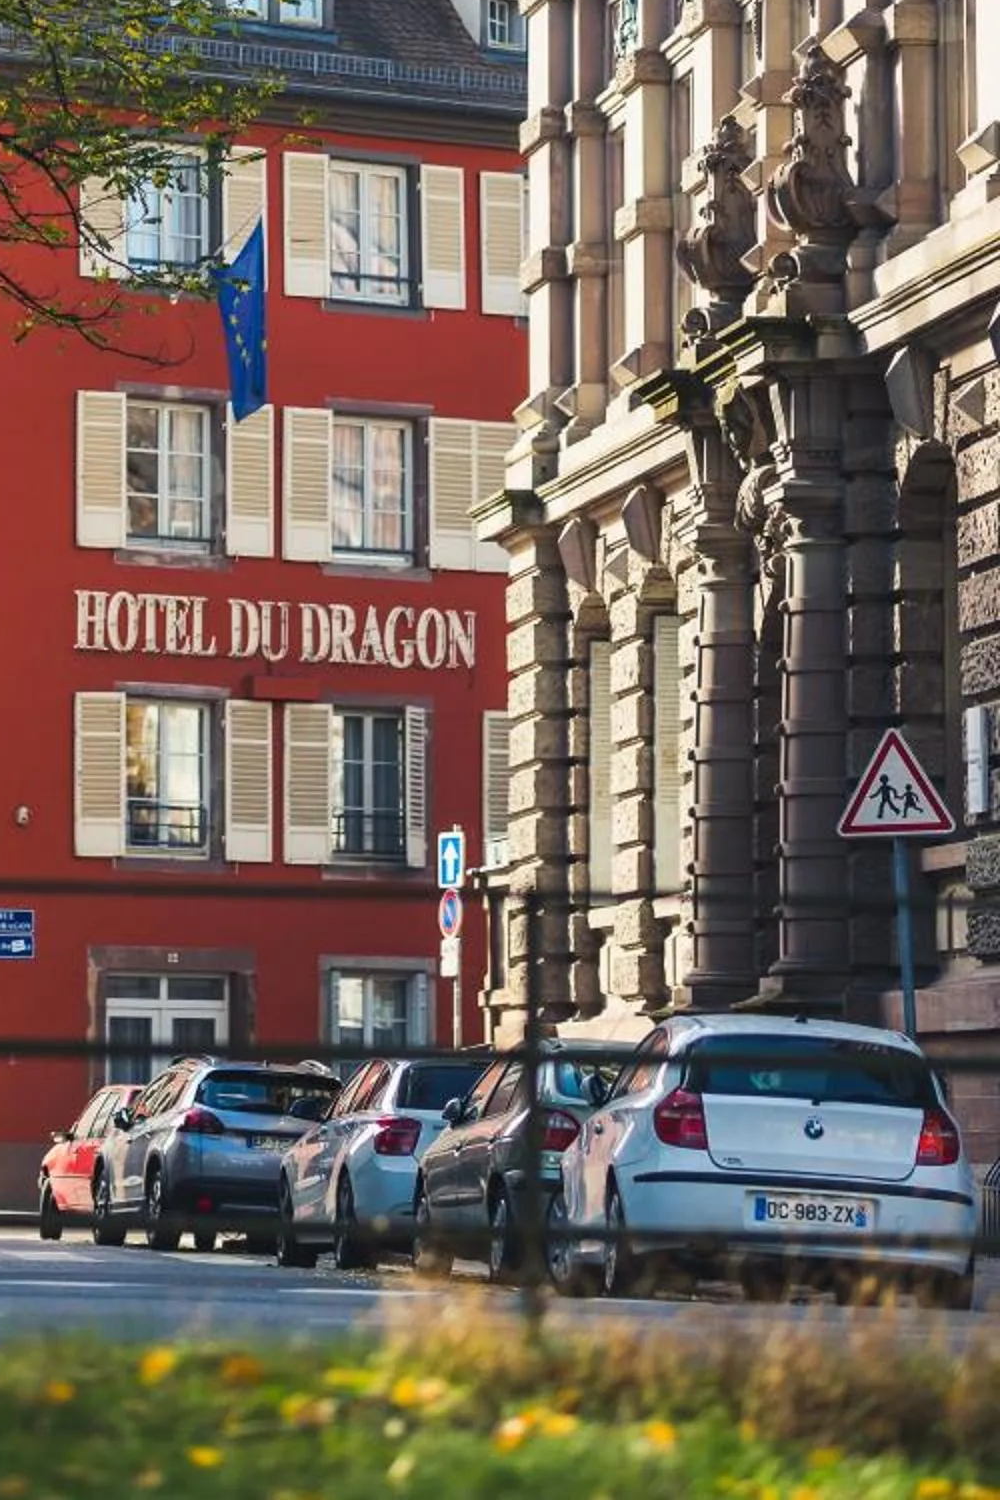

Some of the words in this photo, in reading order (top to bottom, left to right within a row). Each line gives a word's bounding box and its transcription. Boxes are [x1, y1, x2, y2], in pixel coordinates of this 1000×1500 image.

[73, 588, 217, 655] HOTEL
[227, 598, 290, 663] DU
[299, 603, 478, 670] DRAGON
